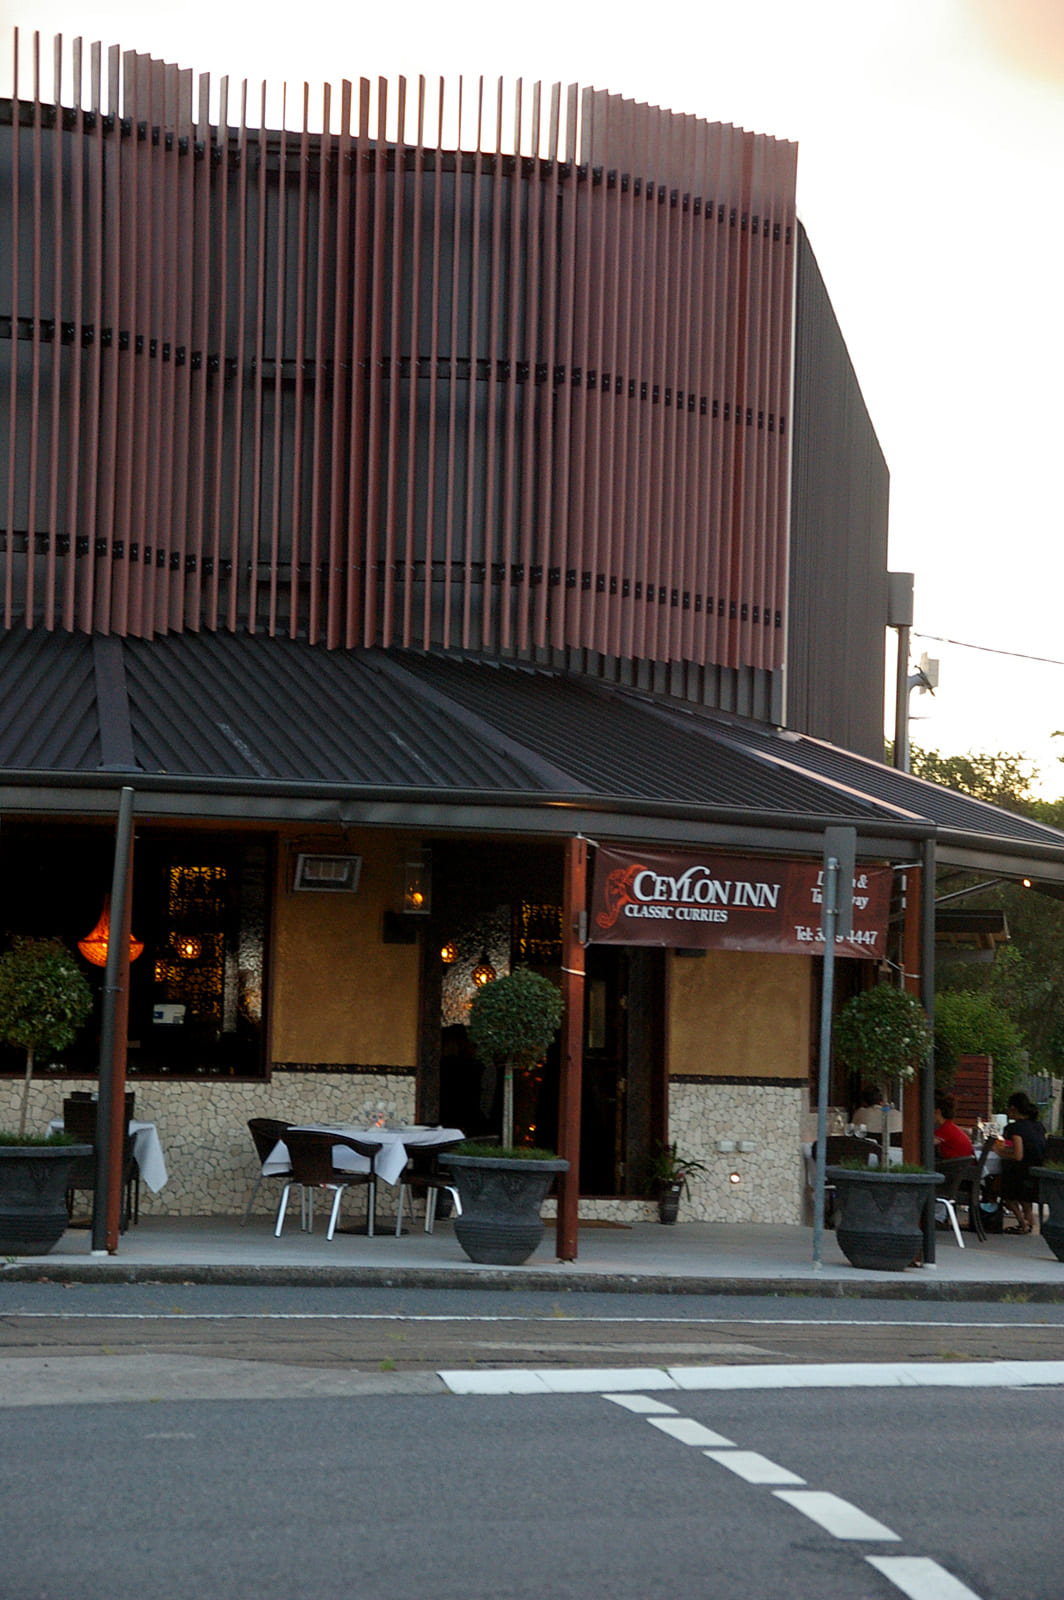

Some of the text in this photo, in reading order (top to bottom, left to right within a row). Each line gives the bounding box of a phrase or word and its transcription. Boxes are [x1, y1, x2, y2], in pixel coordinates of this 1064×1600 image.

[633, 865, 781, 908] CEYLON INN
[857, 874, 868, 889] &
[624, 904, 729, 923] CLASSIC CURRIES
[846, 929, 879, 945] 4447
